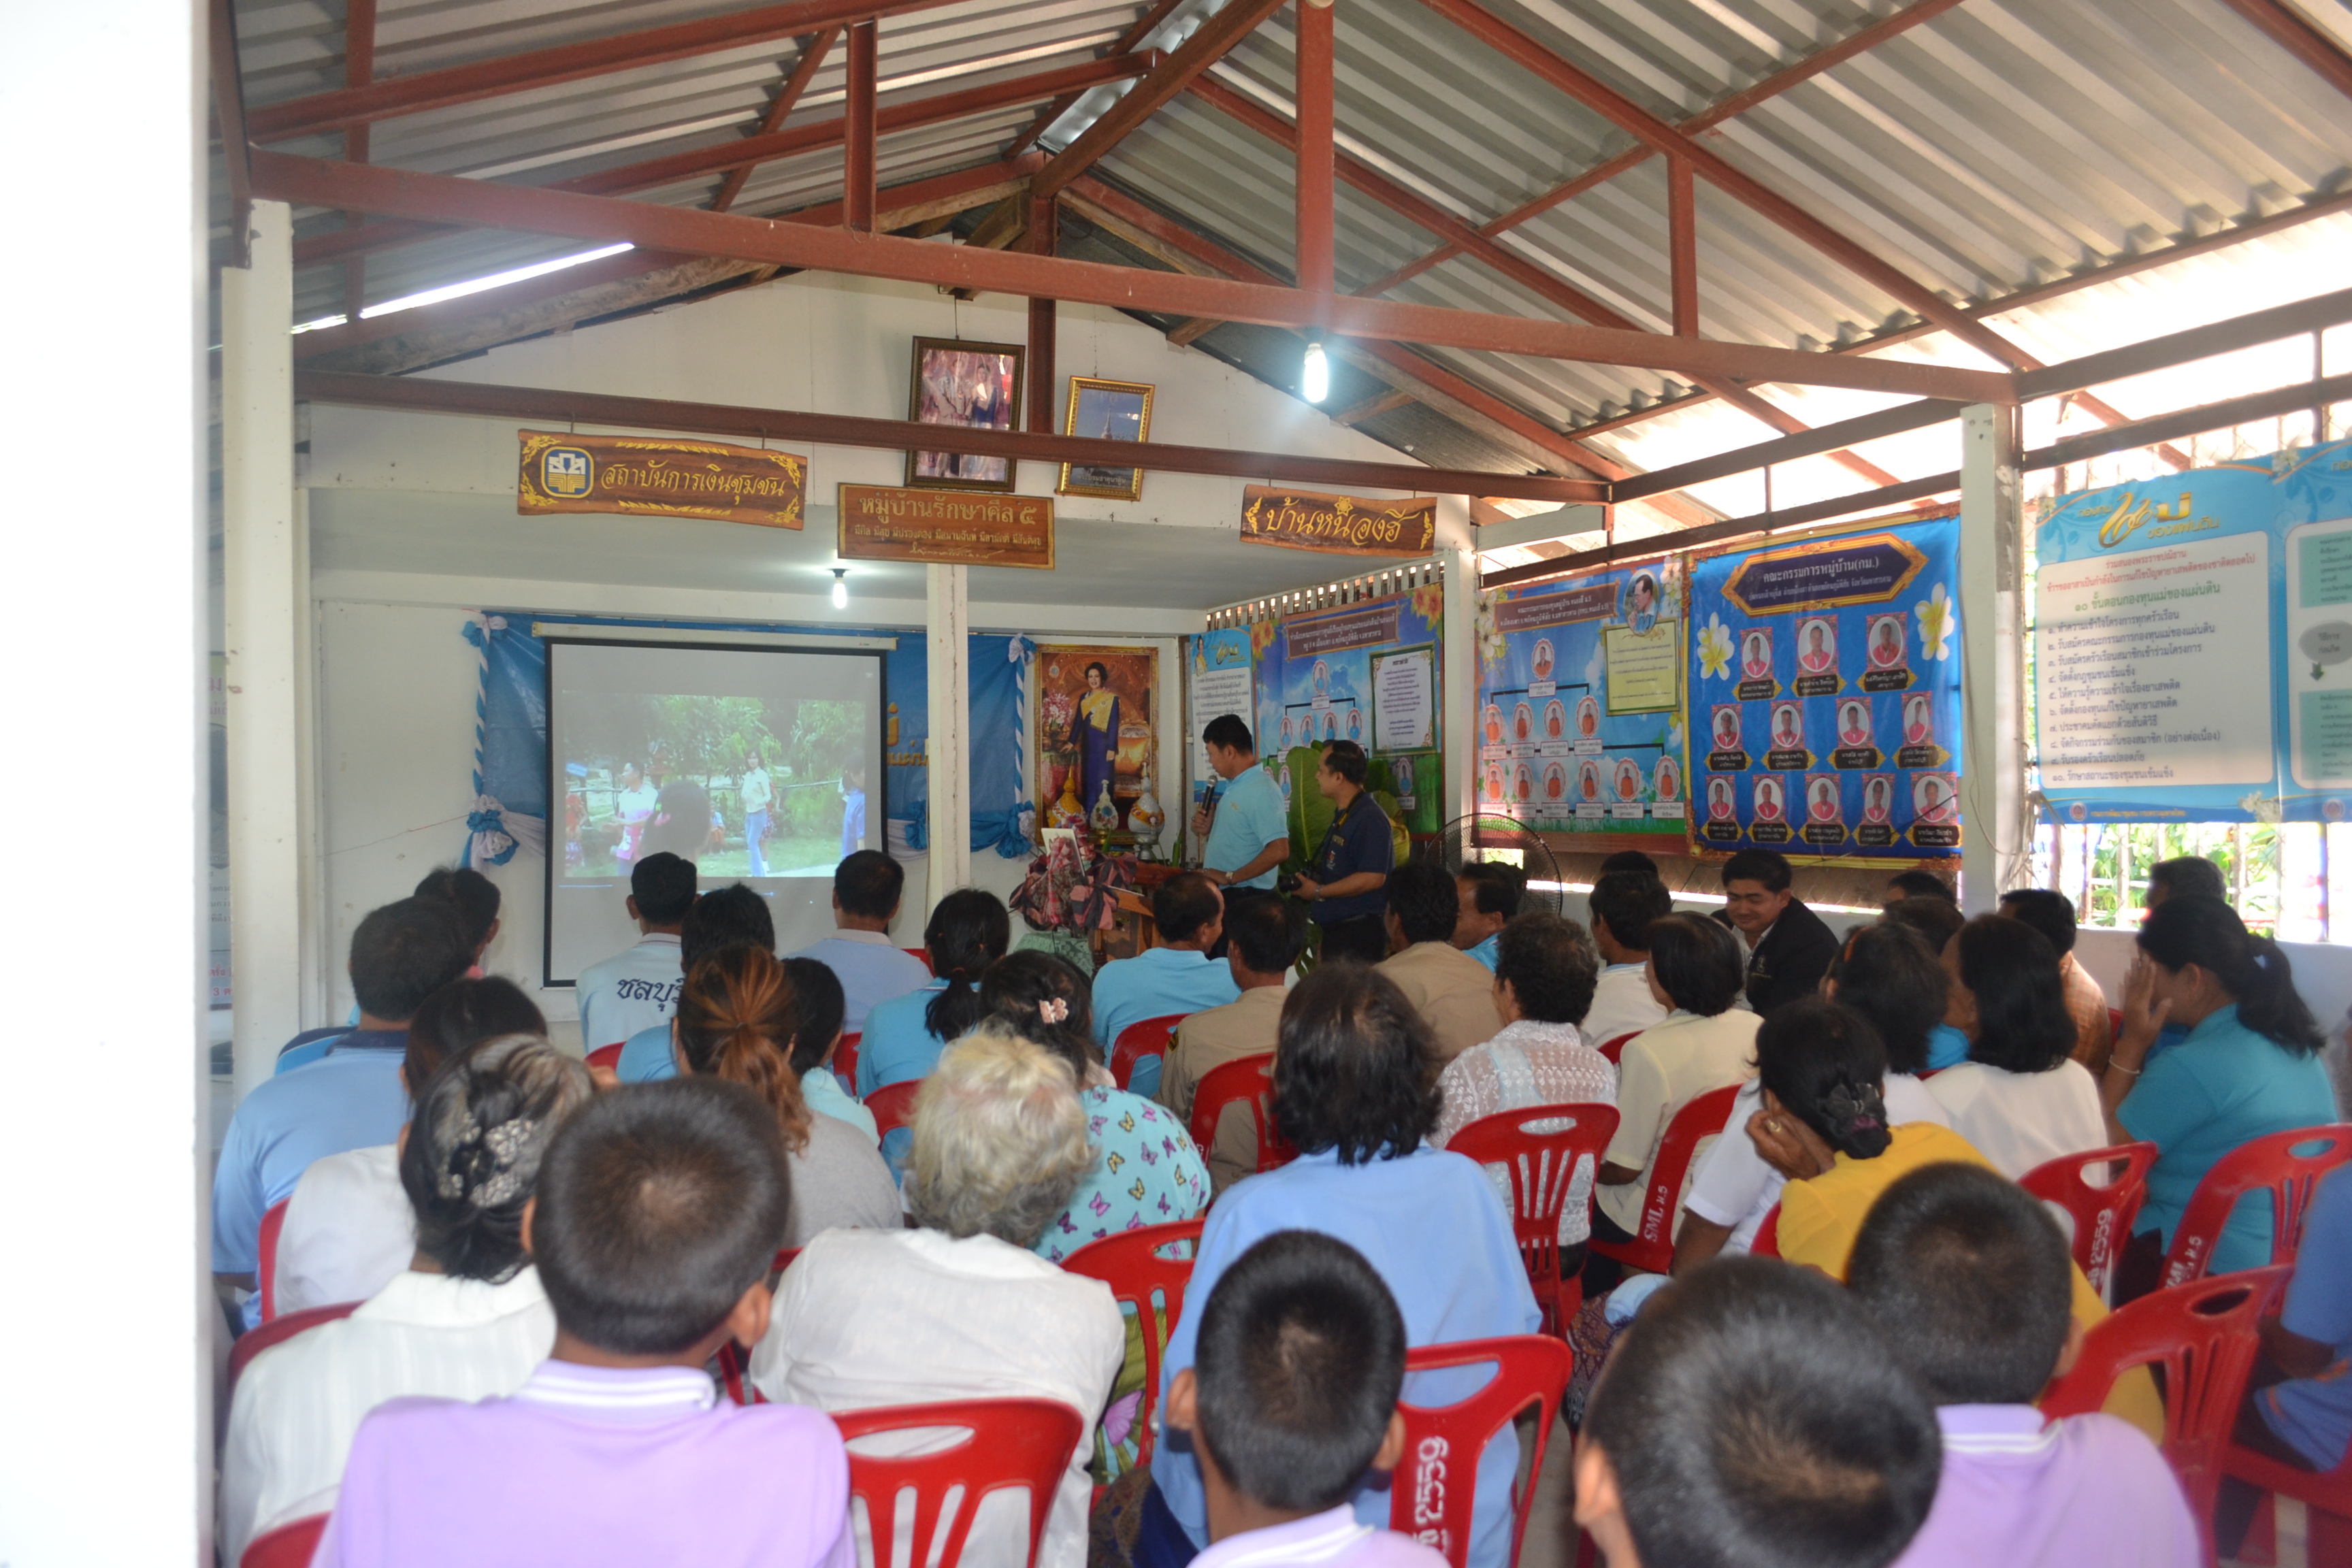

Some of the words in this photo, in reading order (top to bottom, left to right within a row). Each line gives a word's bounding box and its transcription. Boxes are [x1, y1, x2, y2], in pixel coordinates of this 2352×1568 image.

[601, 460, 787, 505] สถาบันการเงินชุมชน
[859, 491, 1014, 525] หมู่บ้านรักษาศีล
[1019, 506, 1038, 525] ๕
[854, 525, 871, 536] มีศีล
[874, 527, 890, 541] มีสุข
[892, 527, 932, 540] มีปรองดอง
[1265, 496, 1422, 546] บ้านหนองฮี
[2146, 516, 2221, 539] ของแผ่นดิน
[1763, 556, 1880, 583] คณะกรรมการหมู่บ้าน(กม.)
[2091, 581, 2221, 609] ขั้นตอนกองทุนแม่ของแผ่นดิน
[2057, 610, 2179, 634] ทำความเข้าใจโครงการทุกครัวเรือน
[2057, 623, 2215, 649] รับสมัครคณะกรรมการกองทุนแม่ของแผ่นดิน
[2058, 642, 2202, 666] รับสมัครครัวเรือนสมาชิกเข้าร่วมโครงการ
[2058, 678, 2180, 701] ให้ความรู้ความเข้าใจเรื่องยาเสพติด
[2059, 698, 2178, 717] จัดตั้งกองทุนแก้ไขปัญหายาเสพติด
[2060, 732, 2161, 748] จัดกิจกรรมร่วมกันของสมาชิก
[2164, 726, 2221, 744] (อย่างต่อเนื่อง)
[2061, 751, 2145, 764] รับรองครัวเรือนปลอดภัย
[1644, 1207, 1665, 1243] SML
[1415, 1435, 1450, 1525] 2559
